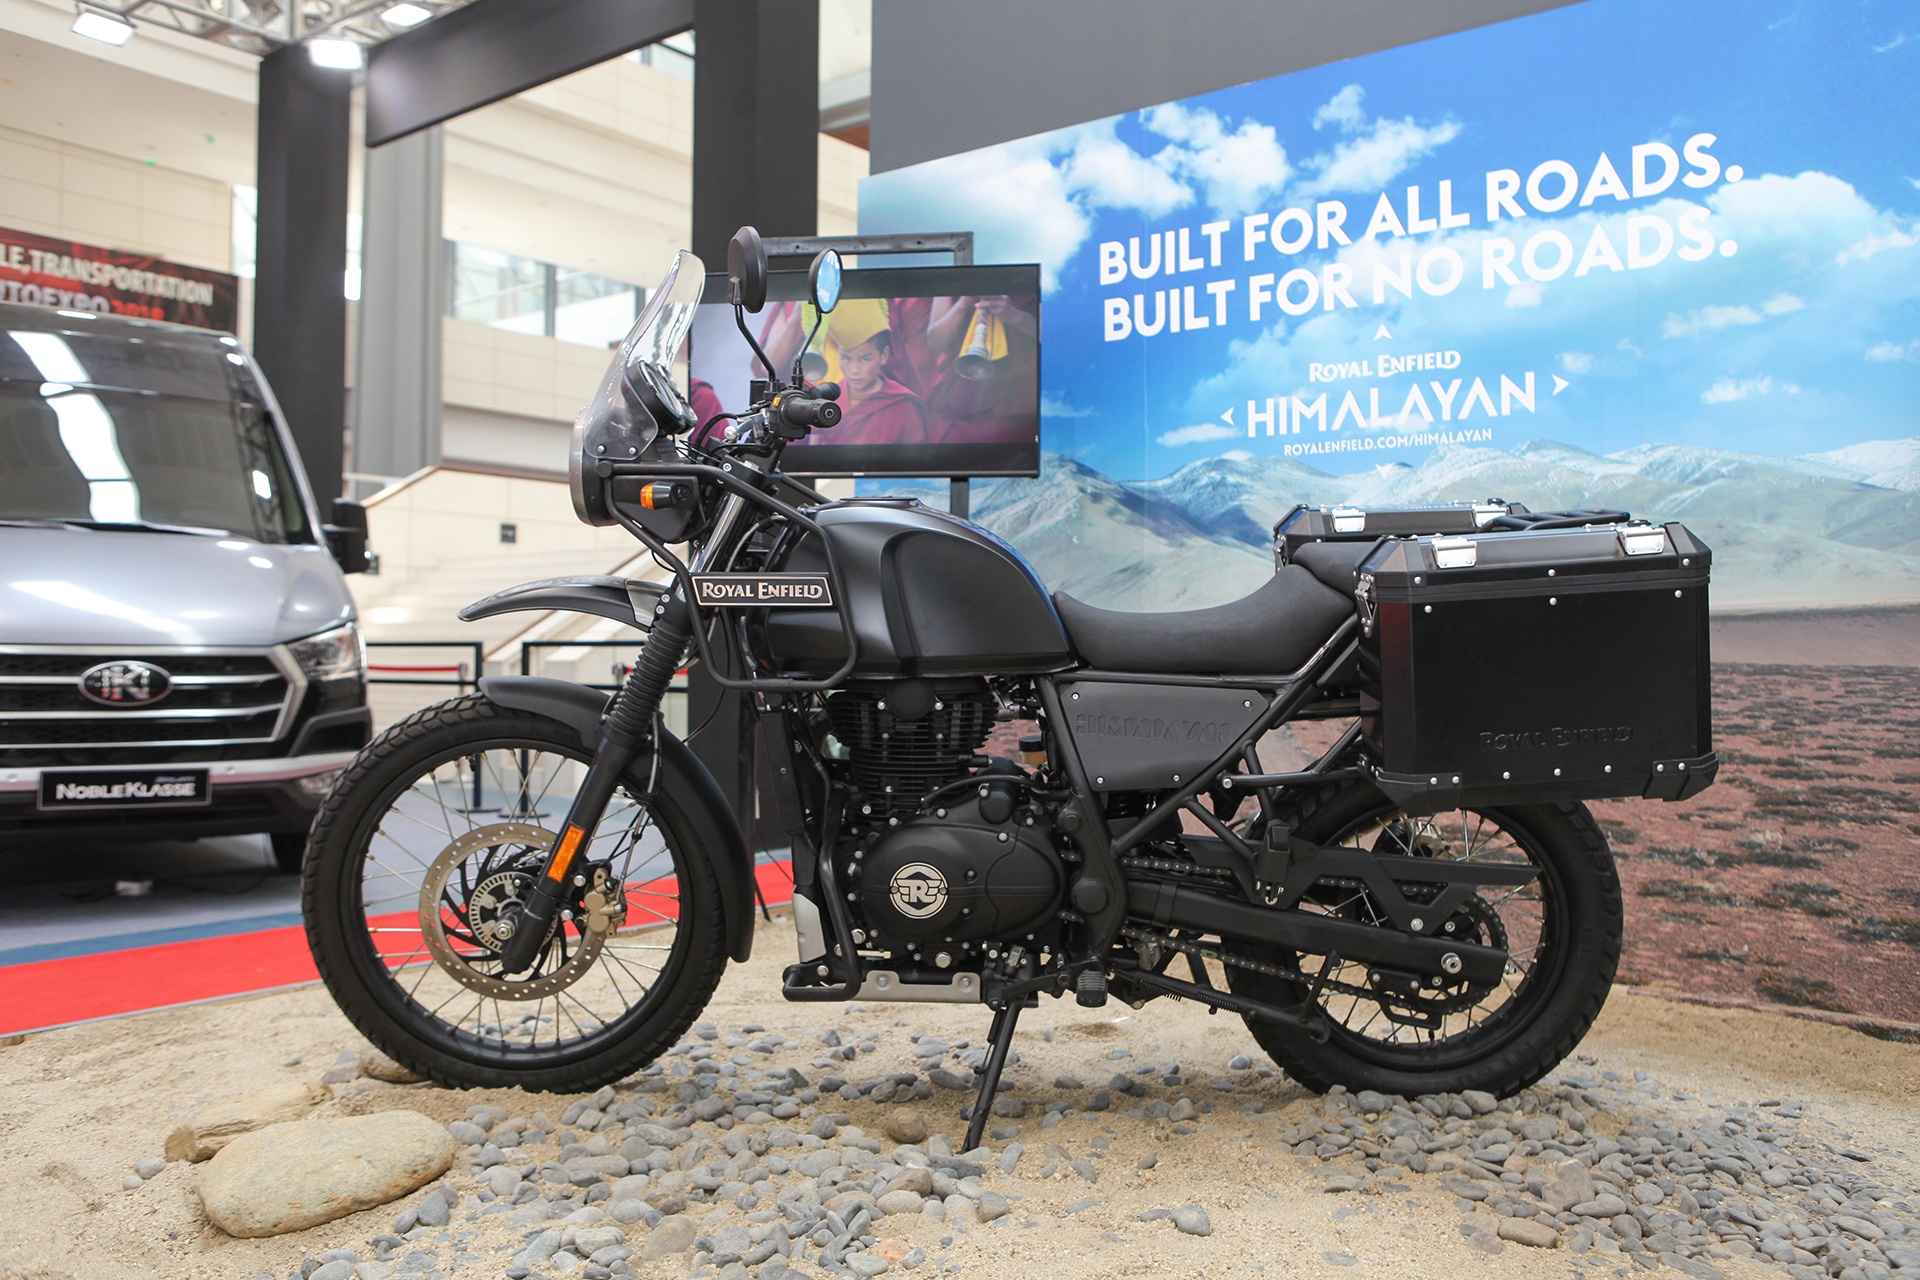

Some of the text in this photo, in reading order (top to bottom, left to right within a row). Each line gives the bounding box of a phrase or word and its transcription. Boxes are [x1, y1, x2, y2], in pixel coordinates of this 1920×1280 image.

[1099, 132, 1745, 286] BUILT FOR ALL ROADS.
[1103, 206, 1739, 343] BUILT FOR NO ROADS.
[1309, 350, 1462, 383] ROYAL ENFIELD
[1247, 371, 1536, 439] HIMALAYAN
[1284, 427, 1493, 457] ROYALENFIELD.COM/HIMALAYAN
[702, 582, 823, 600] ROYAL ENFIELD
[1480, 726, 1634, 752] ROYAL ENFIELD
